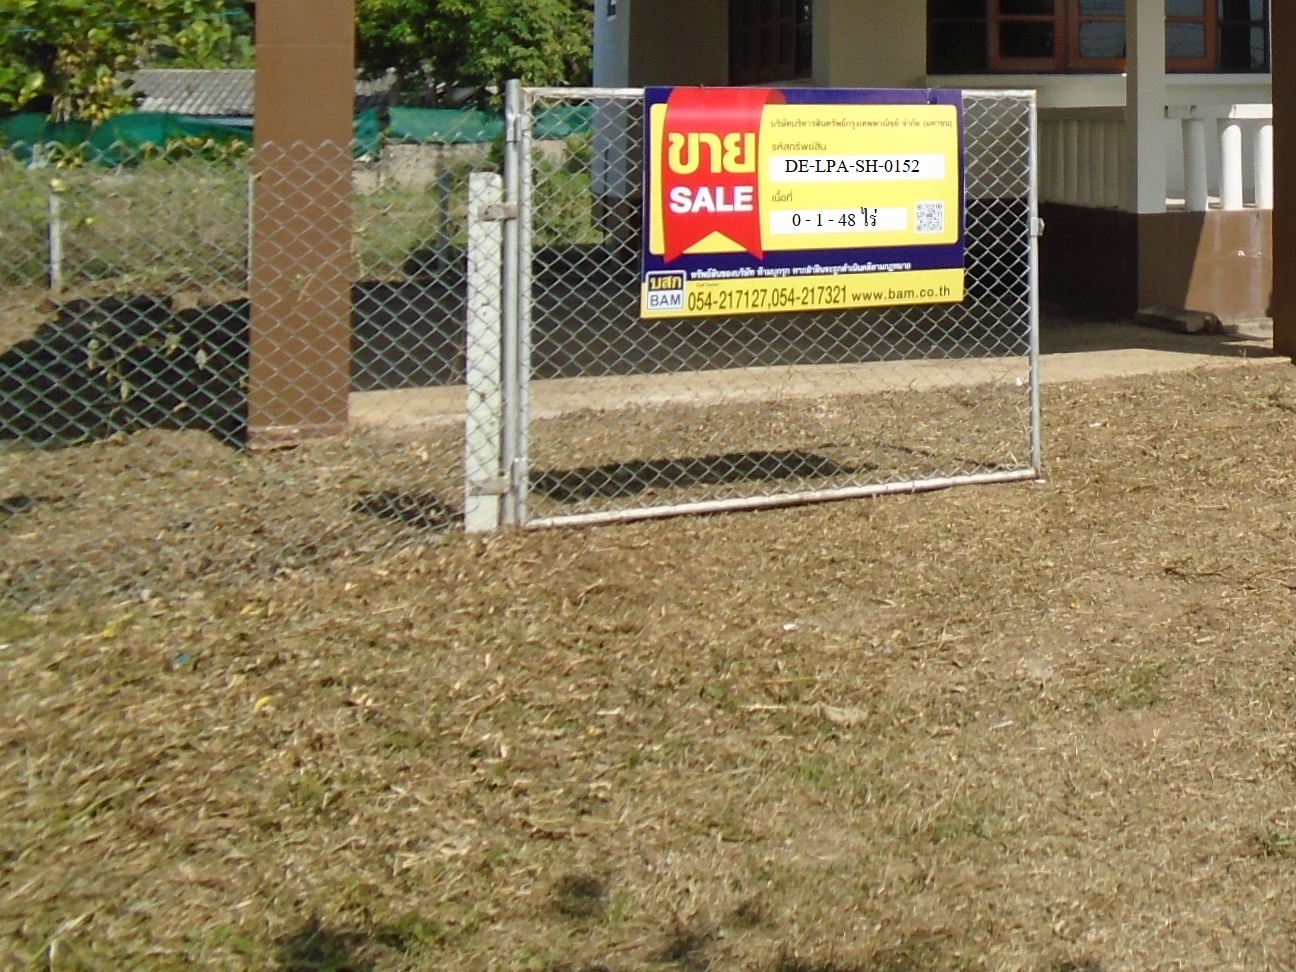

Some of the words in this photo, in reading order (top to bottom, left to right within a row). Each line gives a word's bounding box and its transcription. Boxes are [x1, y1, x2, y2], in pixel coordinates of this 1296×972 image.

[772, 140, 827, 151] รหัสทรัพย์สิน
[668, 132, 756, 175] ขาย
[669, 186, 754, 214] SALE
[772, 189, 793, 203] เนื้อที่
[650, 275, 682, 290] บสก
[650, 294, 681, 307] BAM
[688, 285, 847, 311] 054-217127,054-217321
[852, 285, 950, 302] www.bam.co.th
